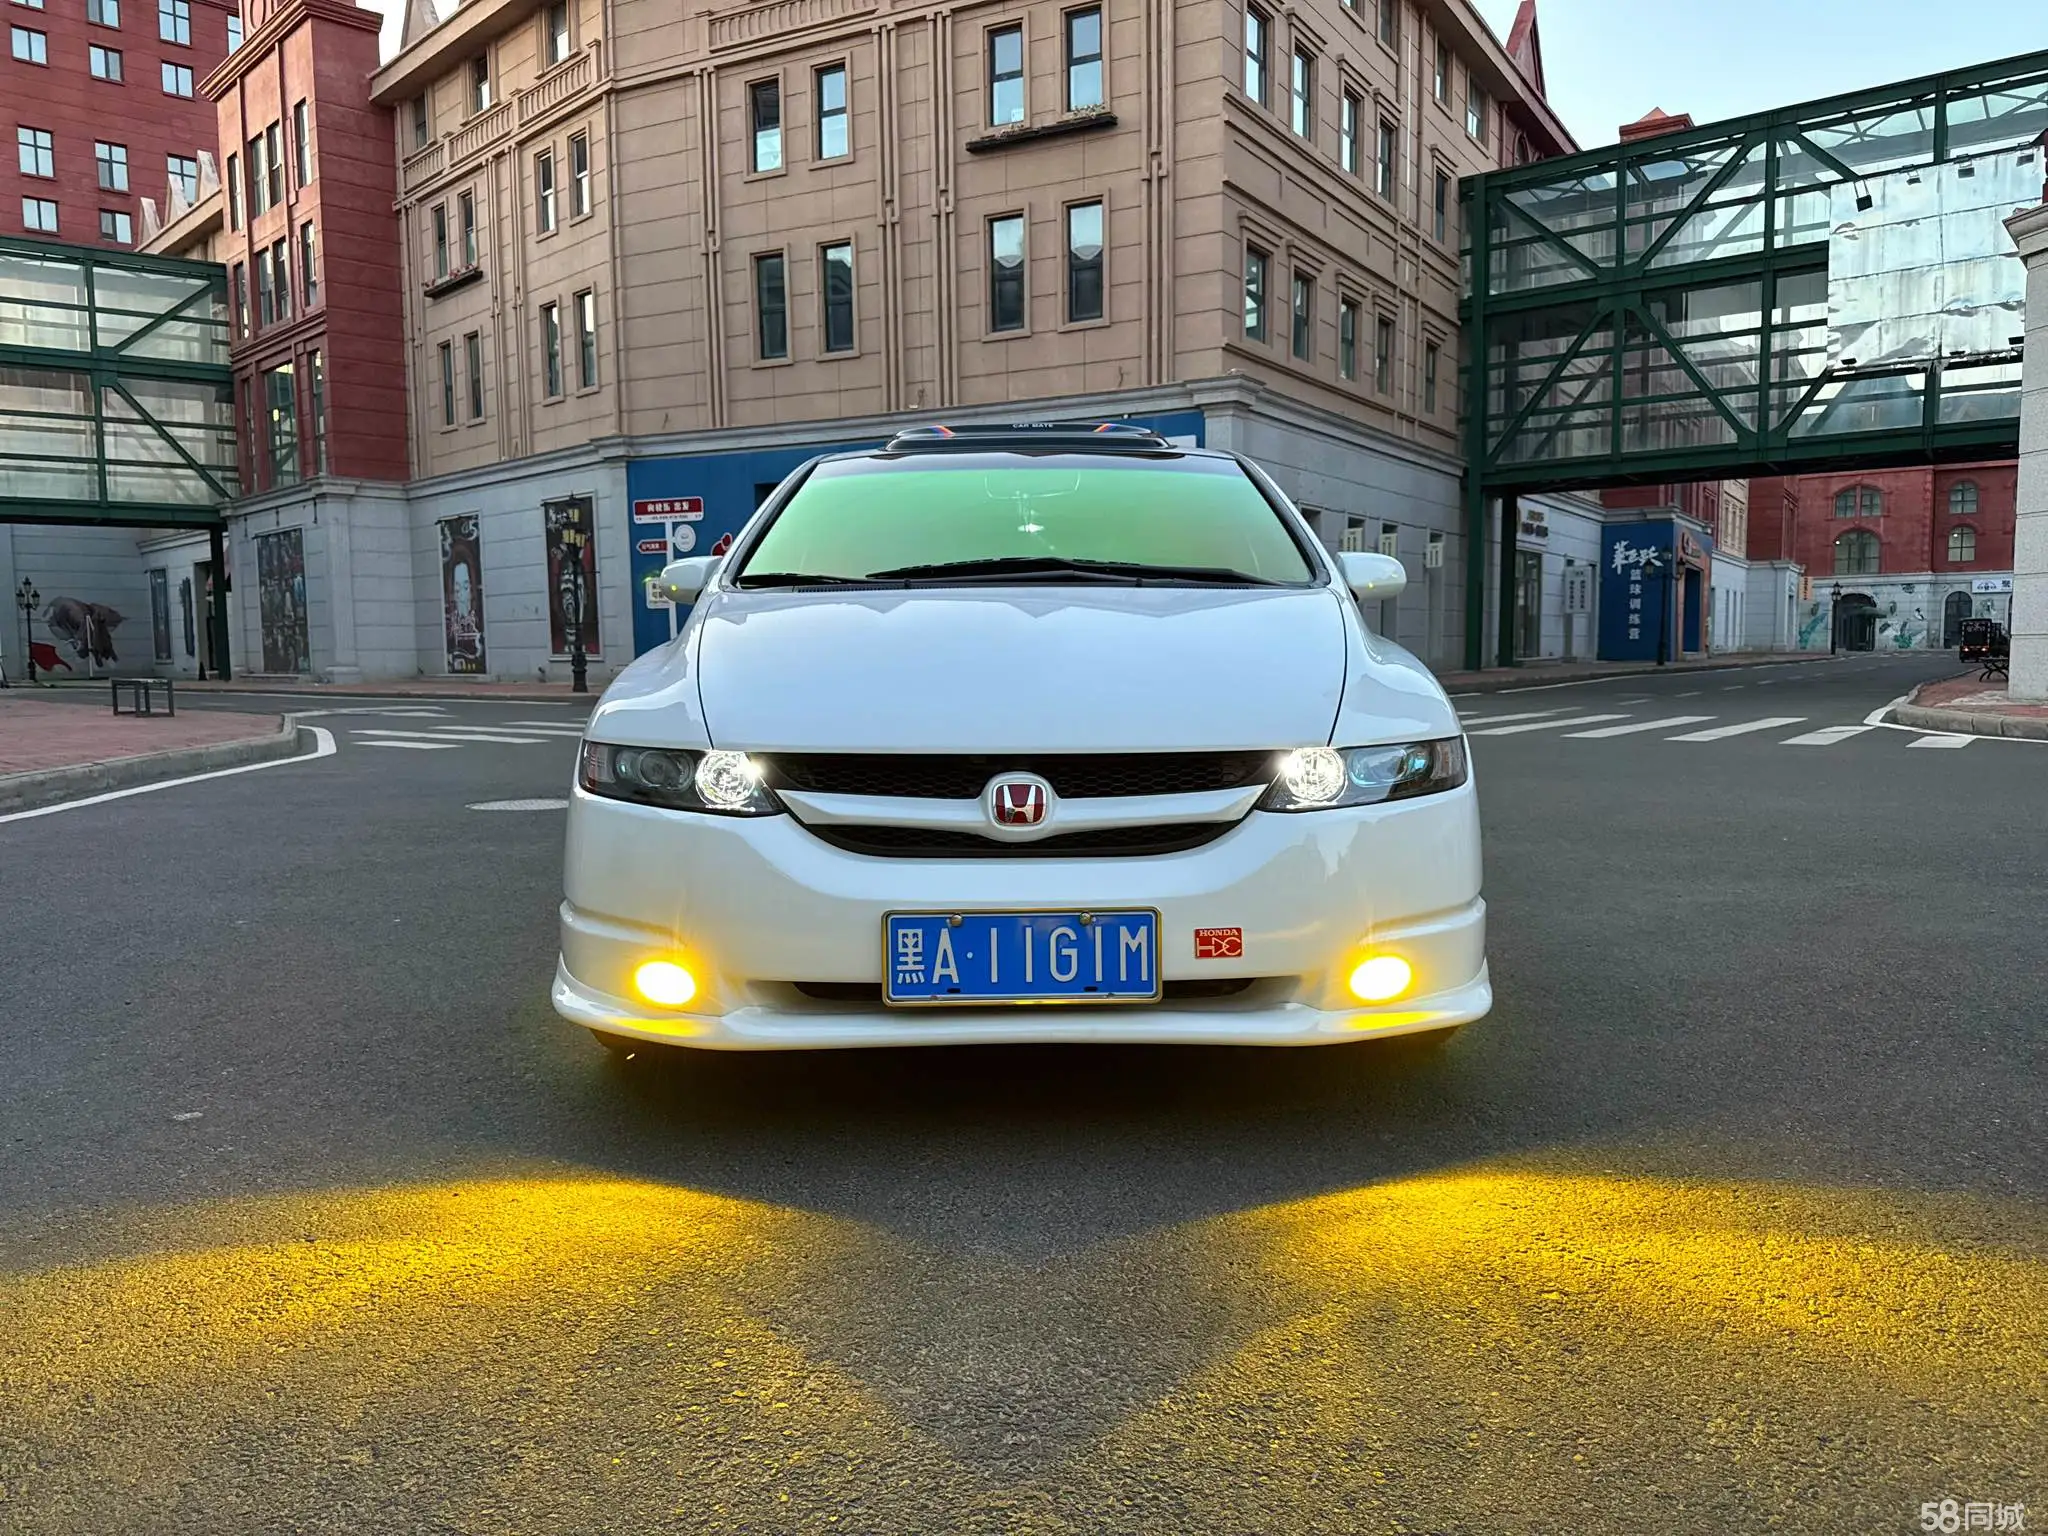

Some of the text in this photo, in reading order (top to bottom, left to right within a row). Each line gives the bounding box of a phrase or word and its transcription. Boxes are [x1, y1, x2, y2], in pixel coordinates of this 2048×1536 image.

[1628, 569, 1642, 640] 篮球训练营
[1200, 929, 1239, 937] HONDA
